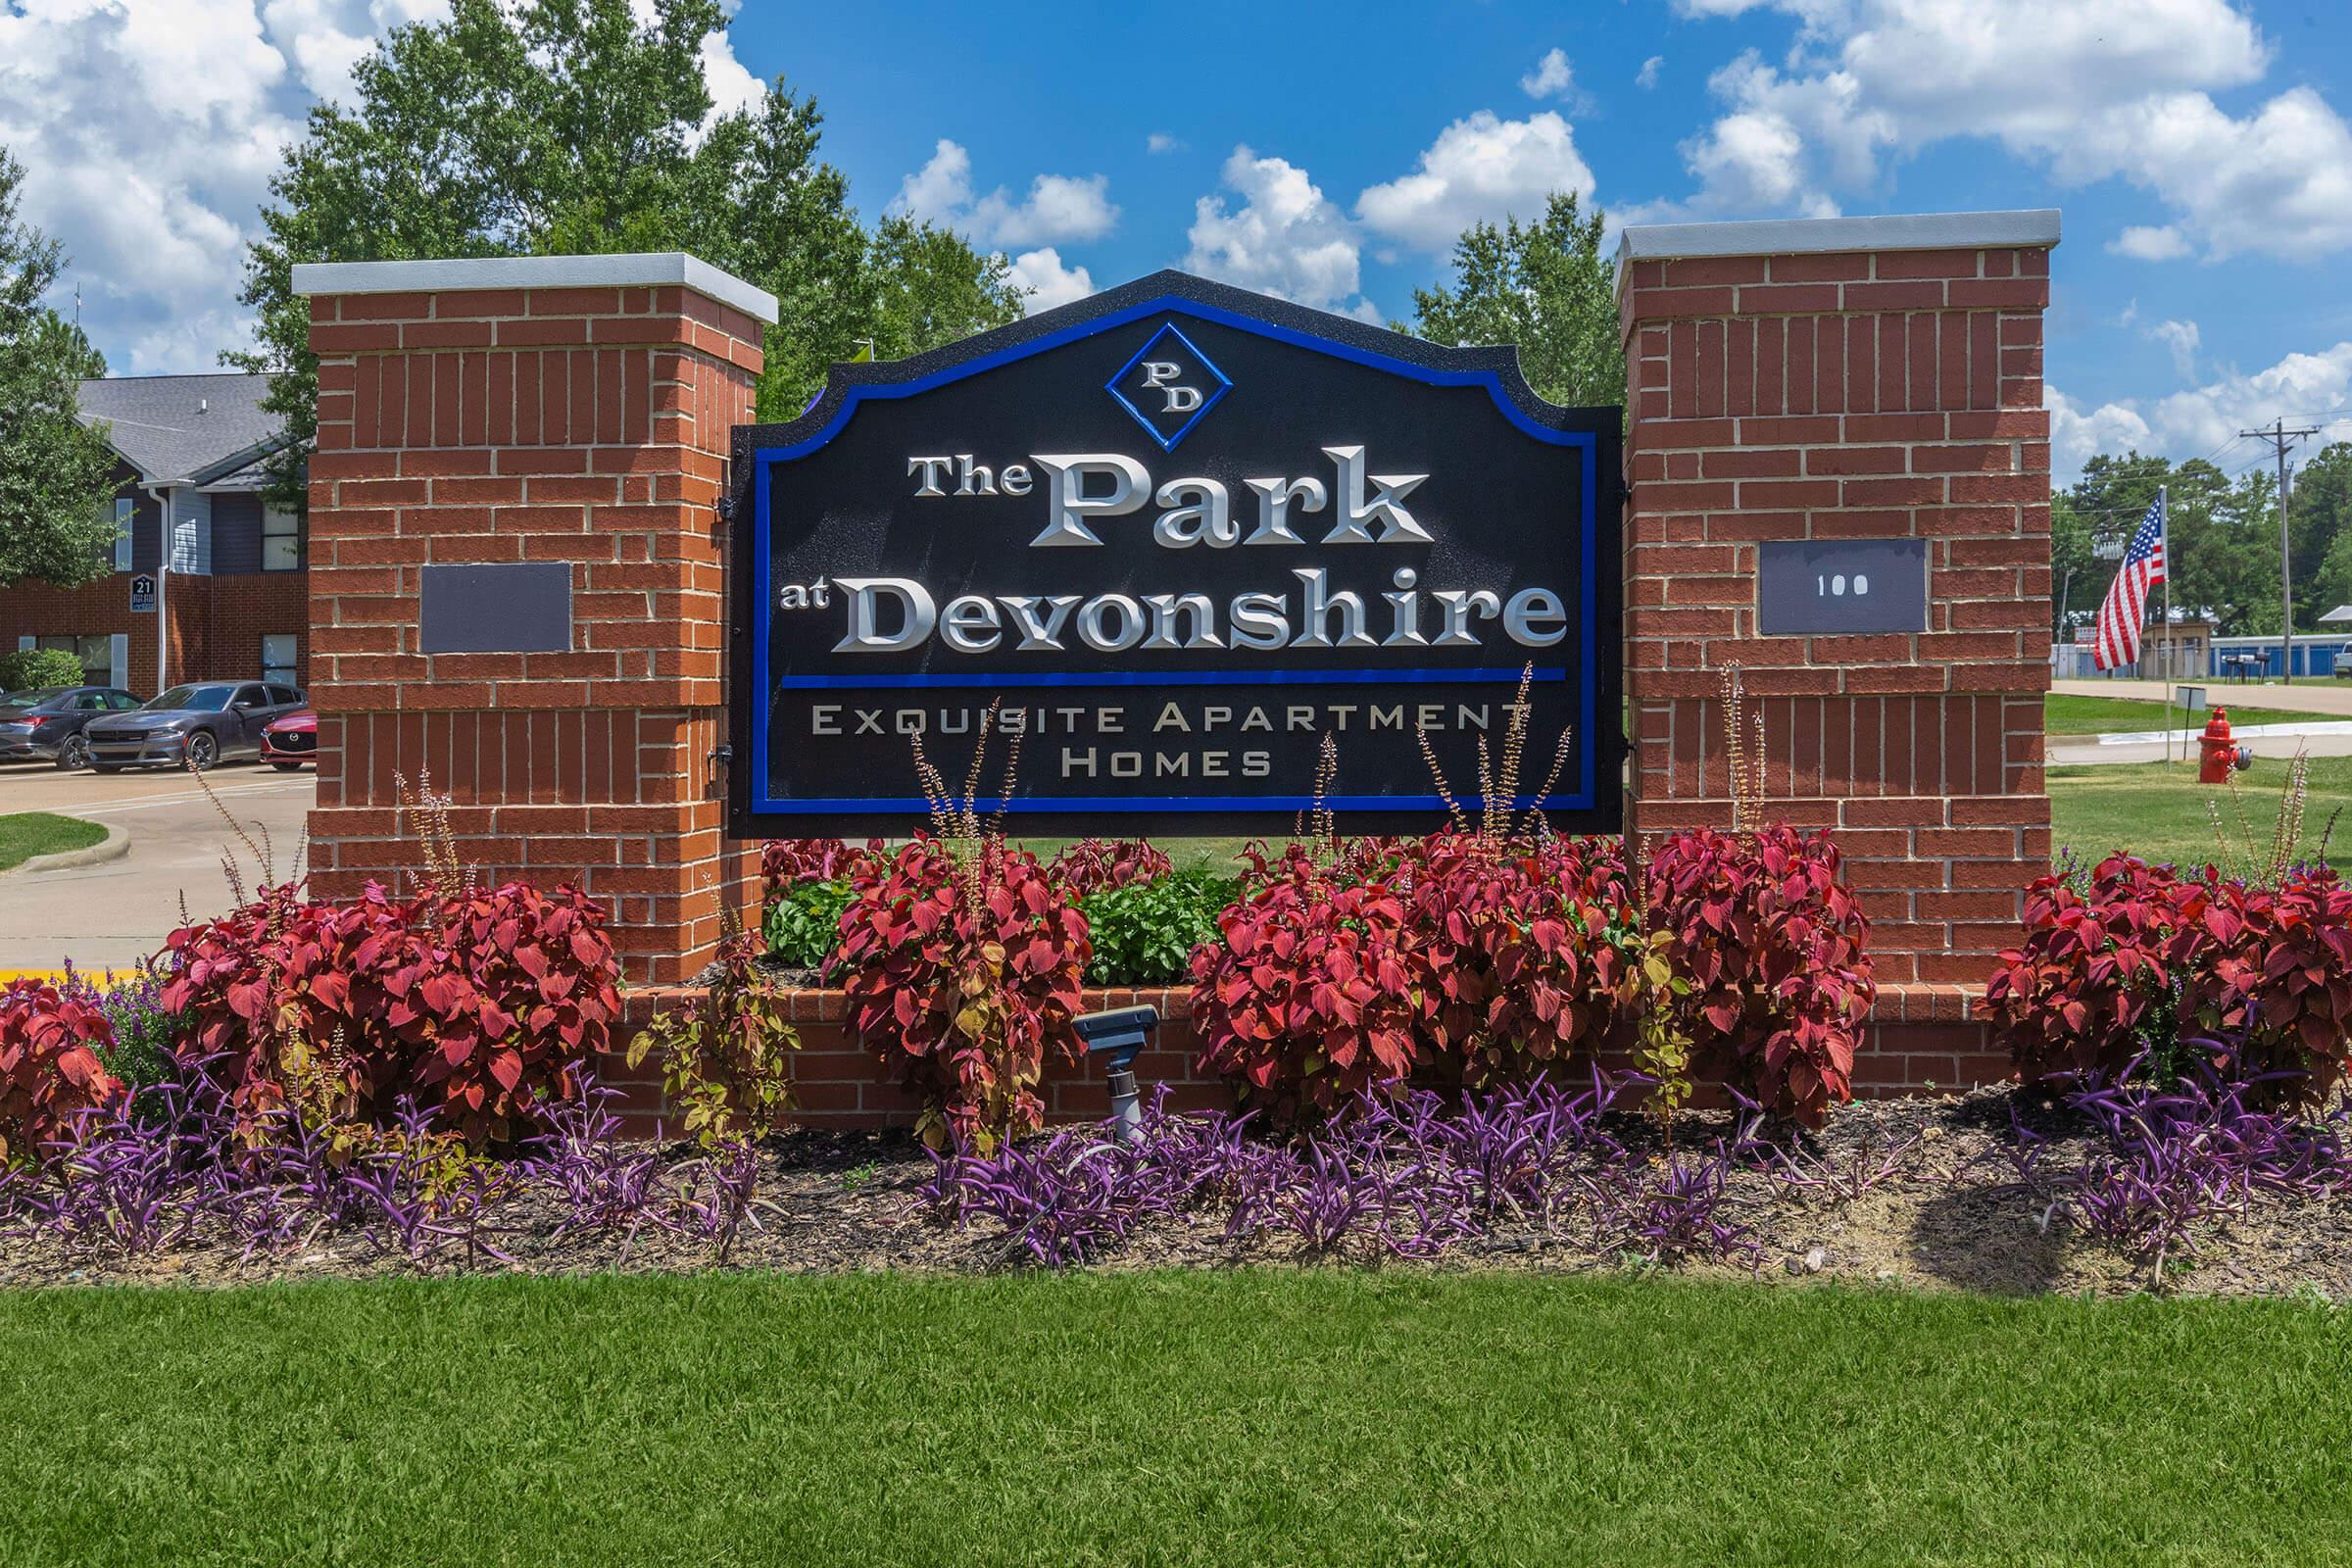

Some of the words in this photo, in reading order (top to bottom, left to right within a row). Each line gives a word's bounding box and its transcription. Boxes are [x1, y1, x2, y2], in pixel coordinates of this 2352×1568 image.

[907, 454, 1034, 497] The
[1029, 445, 1436, 549] Park
[137, 581, 150, 593] 21
[1818, 575, 1868, 596] 100
[780, 575, 832, 610] at
[831, 567, 1568, 653] Devonshire
[812, 705, 1125, 735] EXQUISITE
[1061, 747, 1272, 777] HOMES
